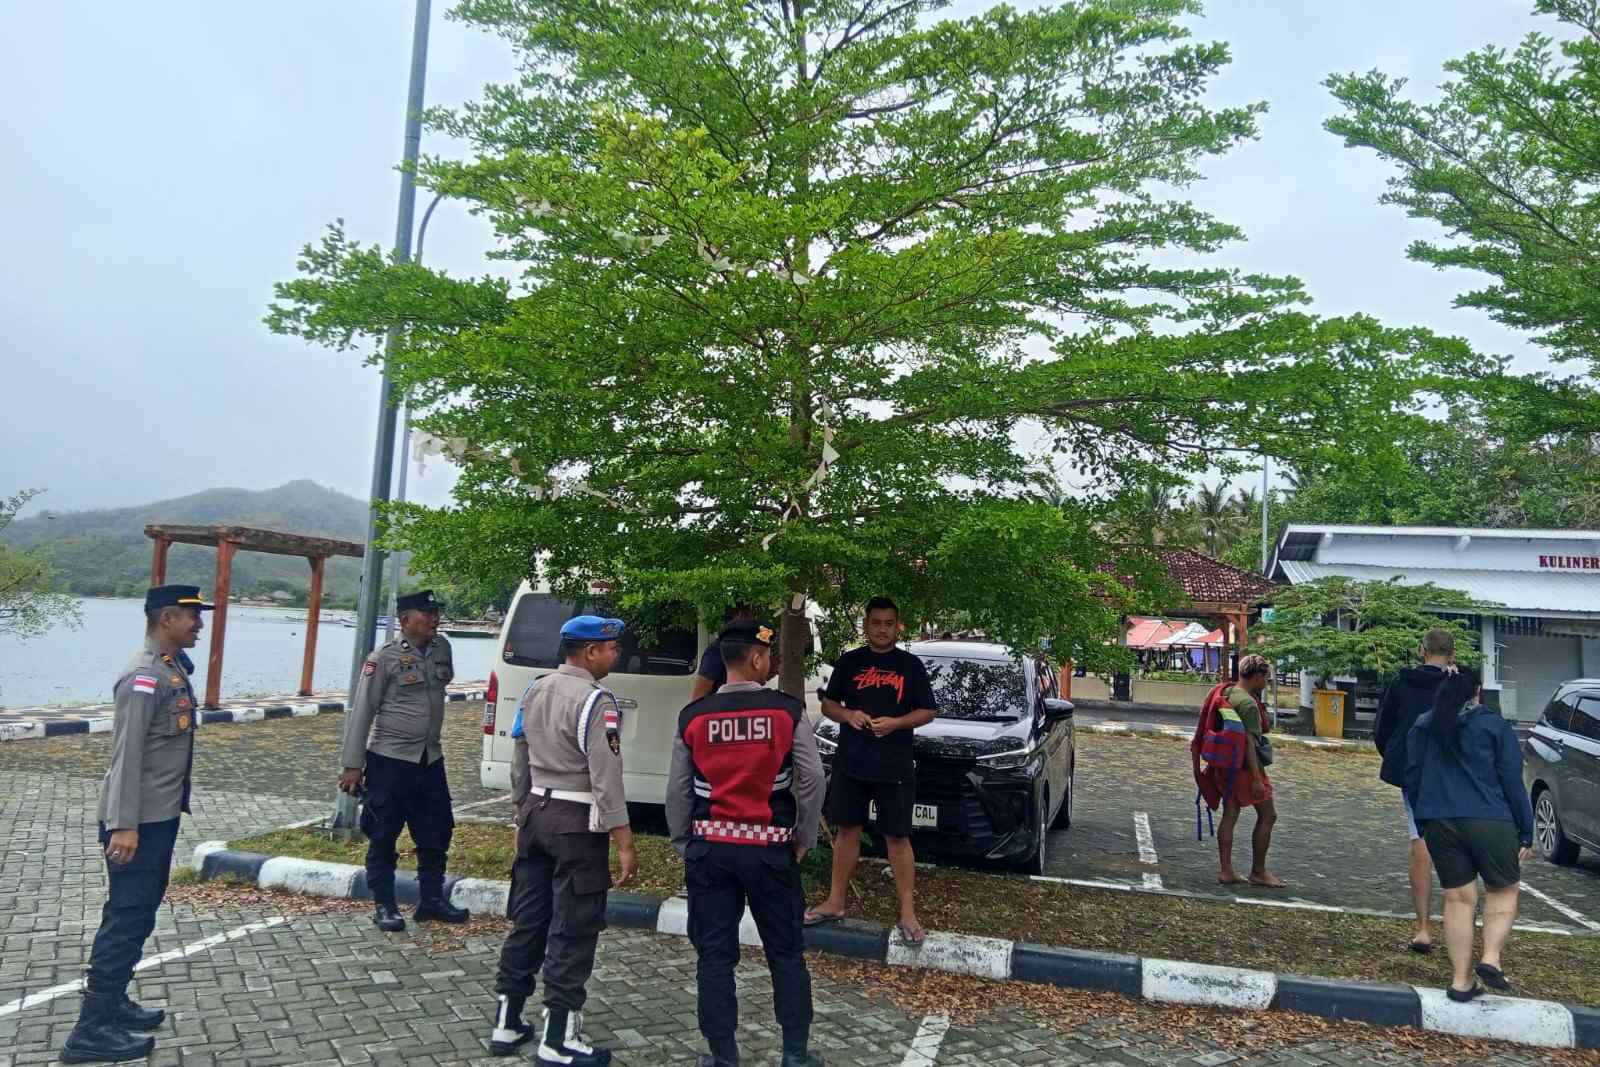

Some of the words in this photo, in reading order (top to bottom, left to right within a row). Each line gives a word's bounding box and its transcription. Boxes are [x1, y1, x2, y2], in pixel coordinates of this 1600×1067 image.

[1539, 555, 1600, 569] KULINER
[708, 717, 771, 742] POLISI
[915, 806, 935, 820] CAL
